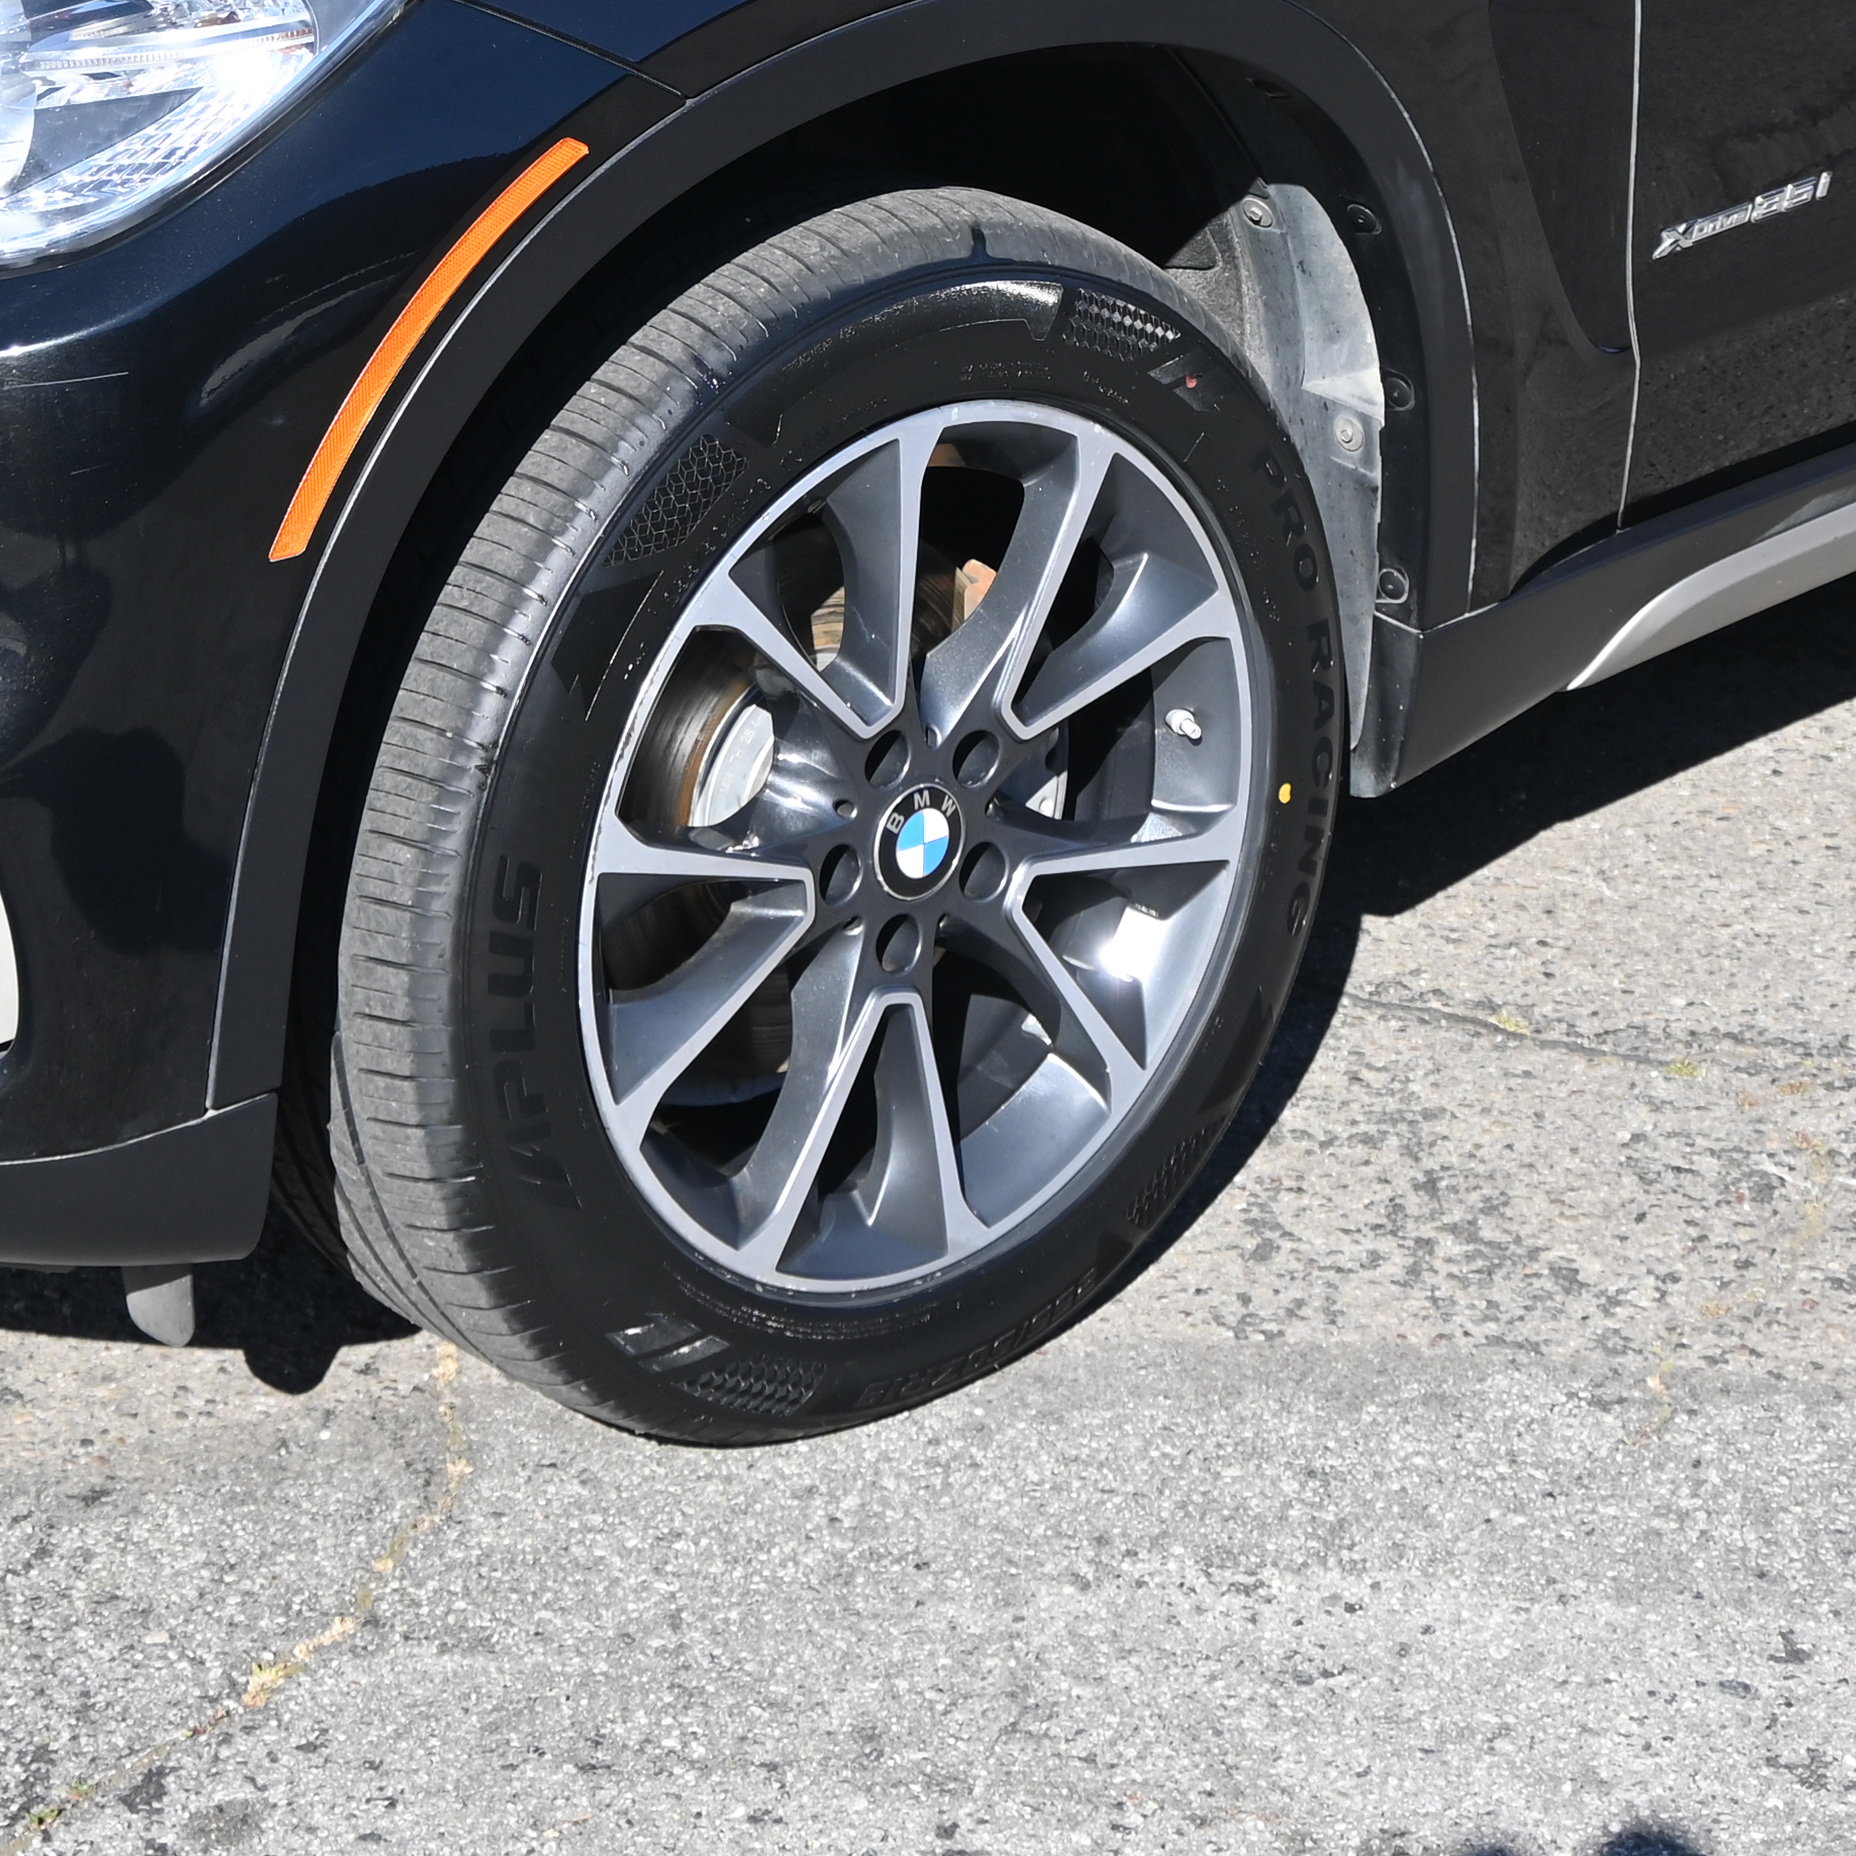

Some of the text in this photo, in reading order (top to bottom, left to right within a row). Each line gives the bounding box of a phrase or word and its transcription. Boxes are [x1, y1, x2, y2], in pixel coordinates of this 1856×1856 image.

[886, 789, 956, 834] BMW
[1250, 450, 1335, 938] PRO RACING
